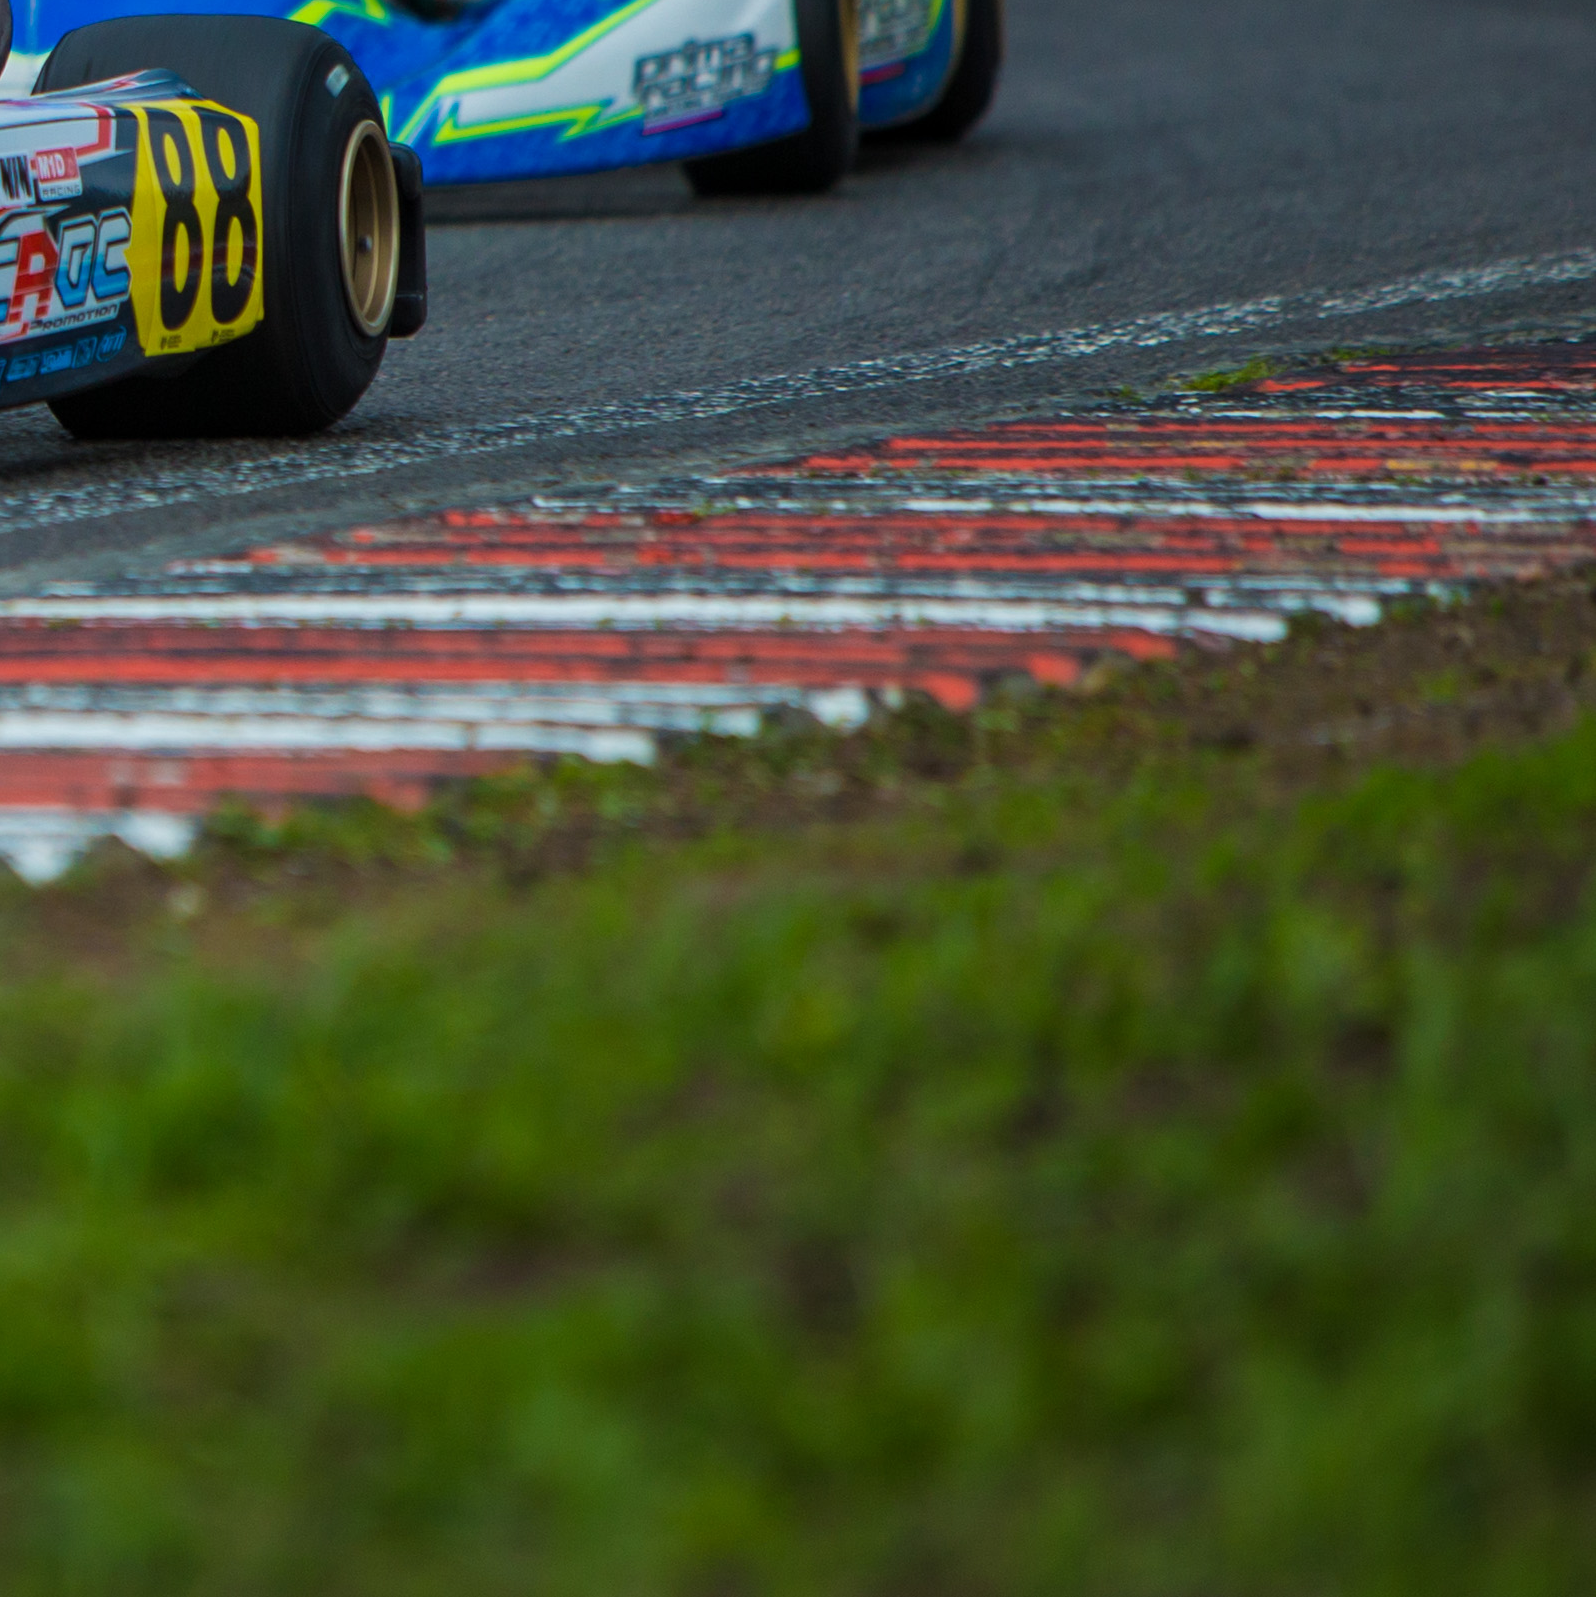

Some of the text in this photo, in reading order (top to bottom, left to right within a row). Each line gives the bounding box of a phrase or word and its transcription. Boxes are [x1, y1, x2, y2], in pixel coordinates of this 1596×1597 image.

[37, 153, 66, 181] M1D
[41, 184, 82, 198] RACING
[148, 106, 258, 332] 88
[29, 304, 119, 331] PROMOTION
